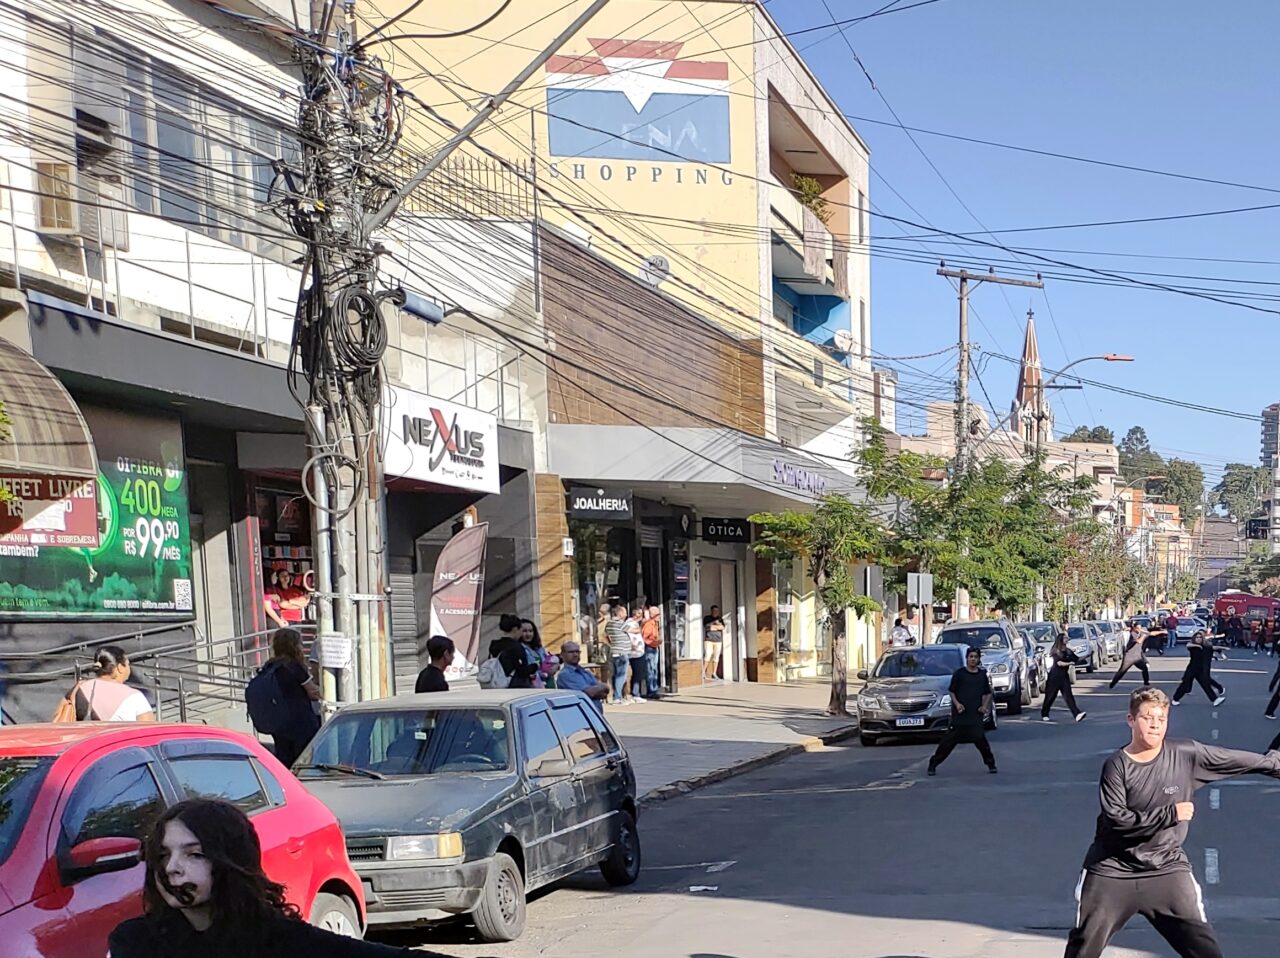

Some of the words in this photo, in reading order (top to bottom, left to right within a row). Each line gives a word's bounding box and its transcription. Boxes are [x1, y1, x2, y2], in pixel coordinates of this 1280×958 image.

[549, 162, 733, 186] SHOPPING
[402, 407, 485, 472] NEXUS
[0, 478, 42, 497] FFET
[49, 479, 93, 498] LIVRE
[121, 478, 161, 516] 400
[573, 497, 629, 512] JOALHERIA
[161, 506, 179, 518] MEGA
[123, 527, 136, 538] POR
[708, 522, 743, 536] ÓTICA
[56, 535, 97, 545] SOBREMESA
[124, 540, 137, 557] R$
